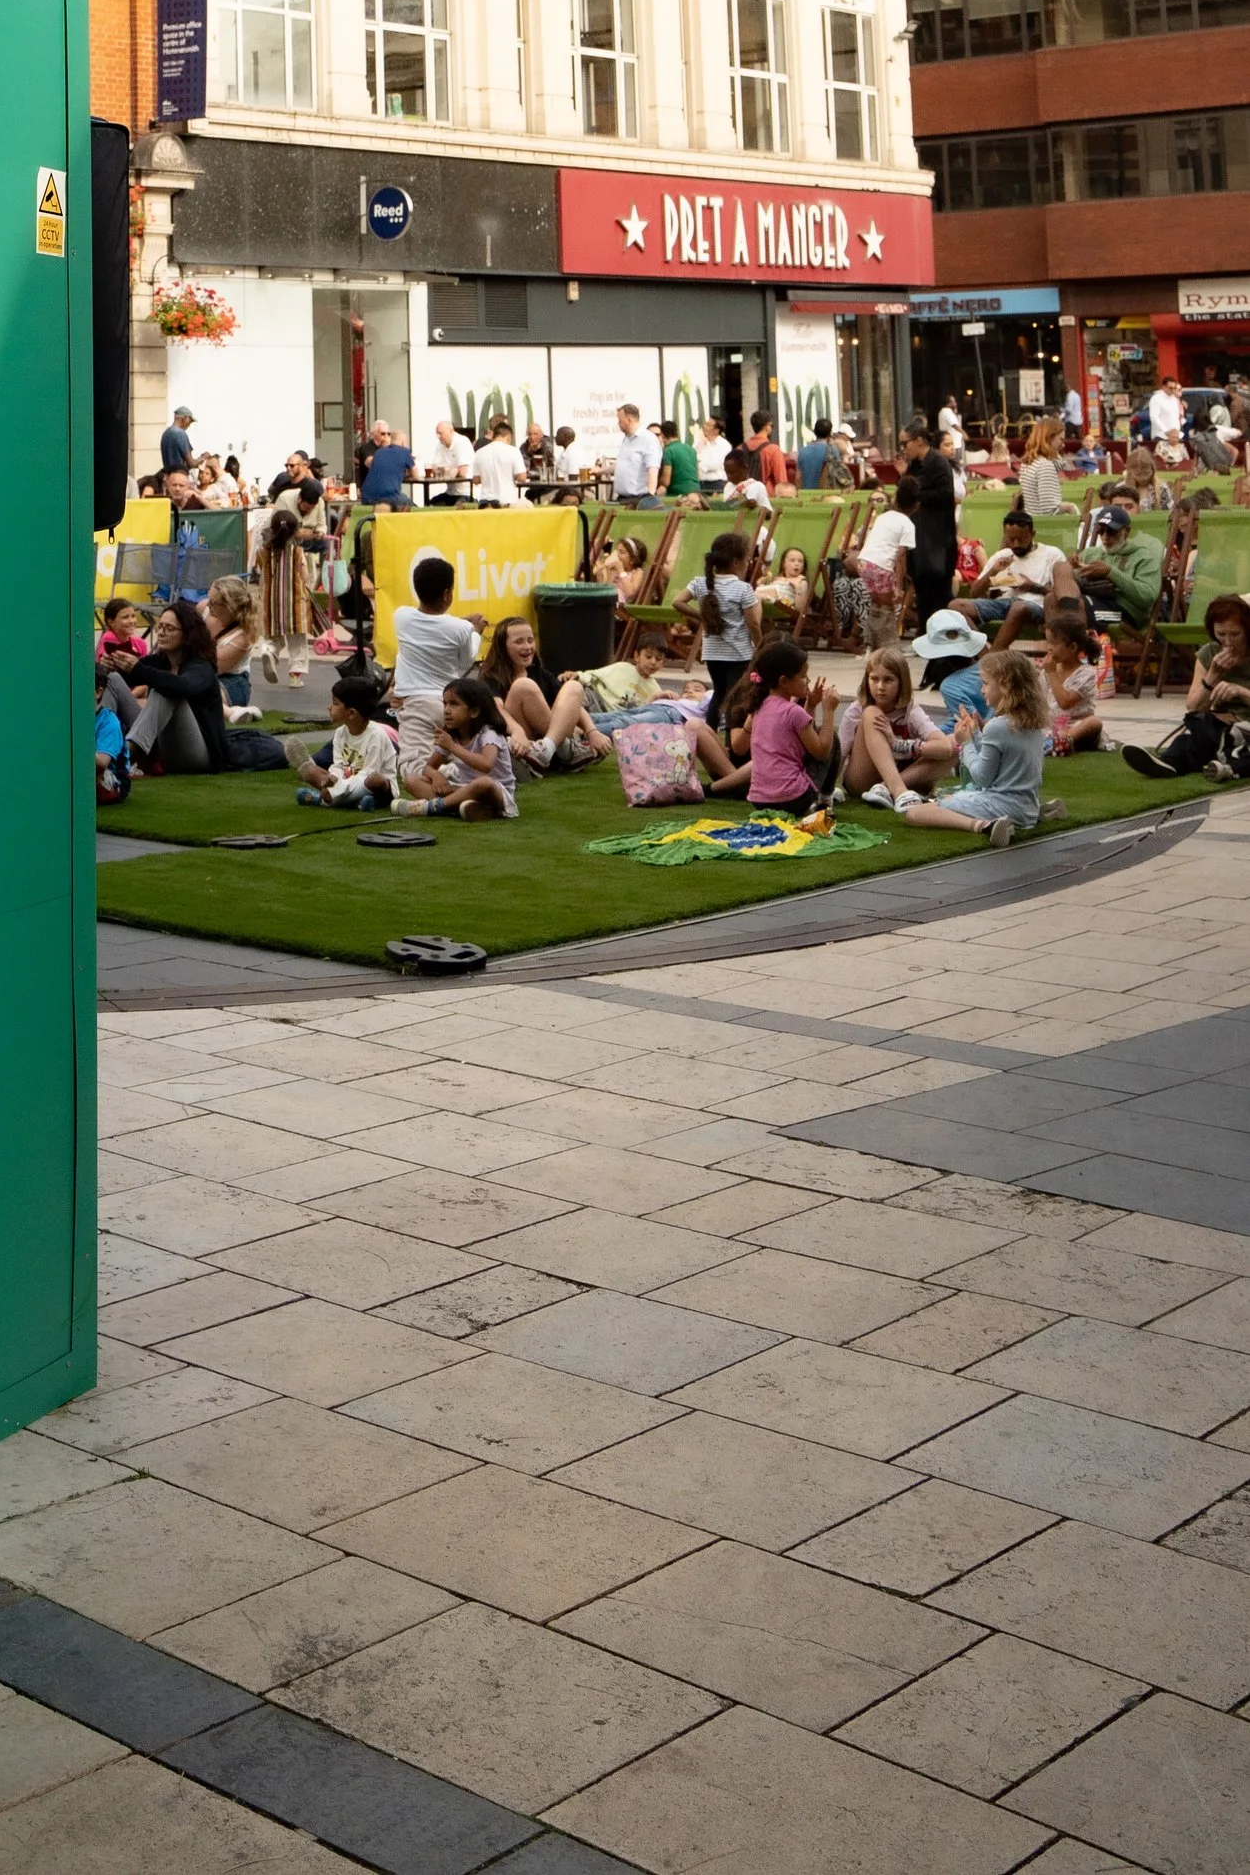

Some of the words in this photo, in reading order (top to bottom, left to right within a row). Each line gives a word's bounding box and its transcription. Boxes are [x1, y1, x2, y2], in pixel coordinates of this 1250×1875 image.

[373, 202, 404, 218] Reed
[41, 228, 60, 242] CCTV
[663, 192, 724, 264] PRET
[731, 196, 750, 266] A
[756, 199, 851, 269] MANGER
[456, 548, 548, 601] Livat
